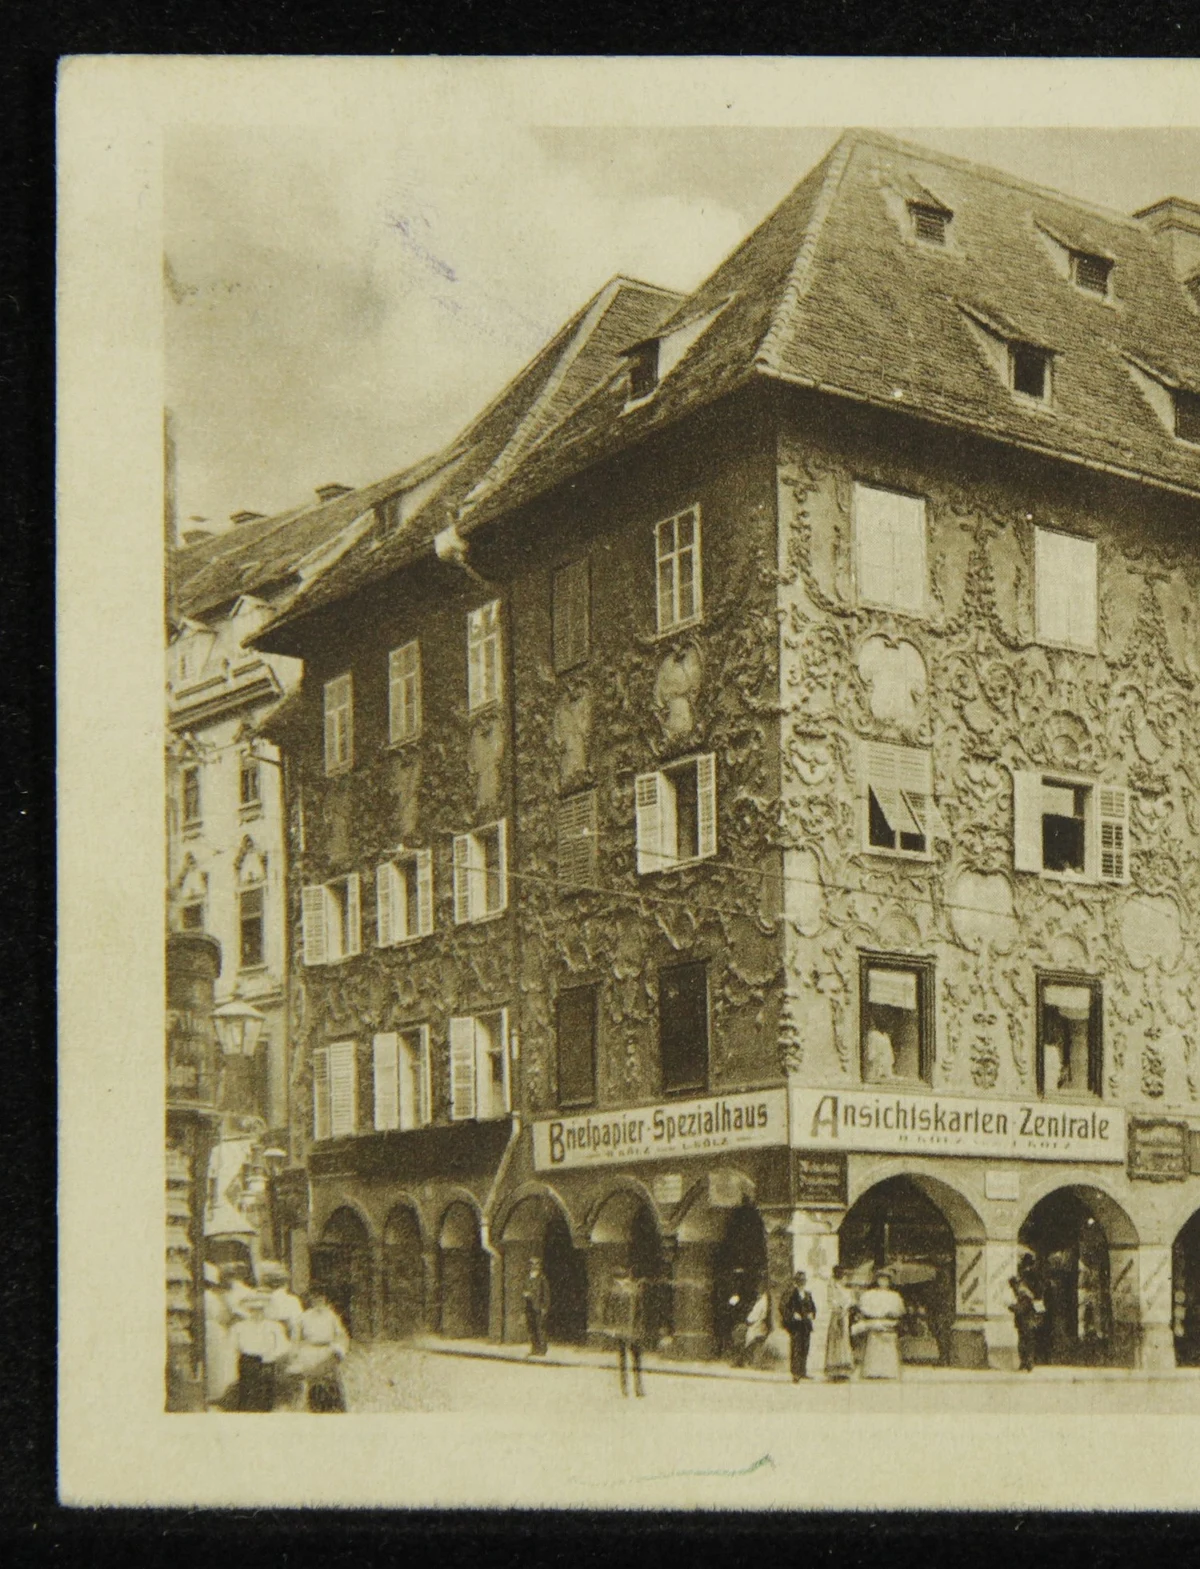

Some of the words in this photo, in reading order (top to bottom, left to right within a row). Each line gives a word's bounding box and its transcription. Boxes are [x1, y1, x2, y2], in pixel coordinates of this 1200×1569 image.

[652, 1100, 769, 1144] Spezialhaus
[810, 1094, 1008, 1138] Ansichtskarten
[1019, 1106, 1111, 1140] Zentrale
